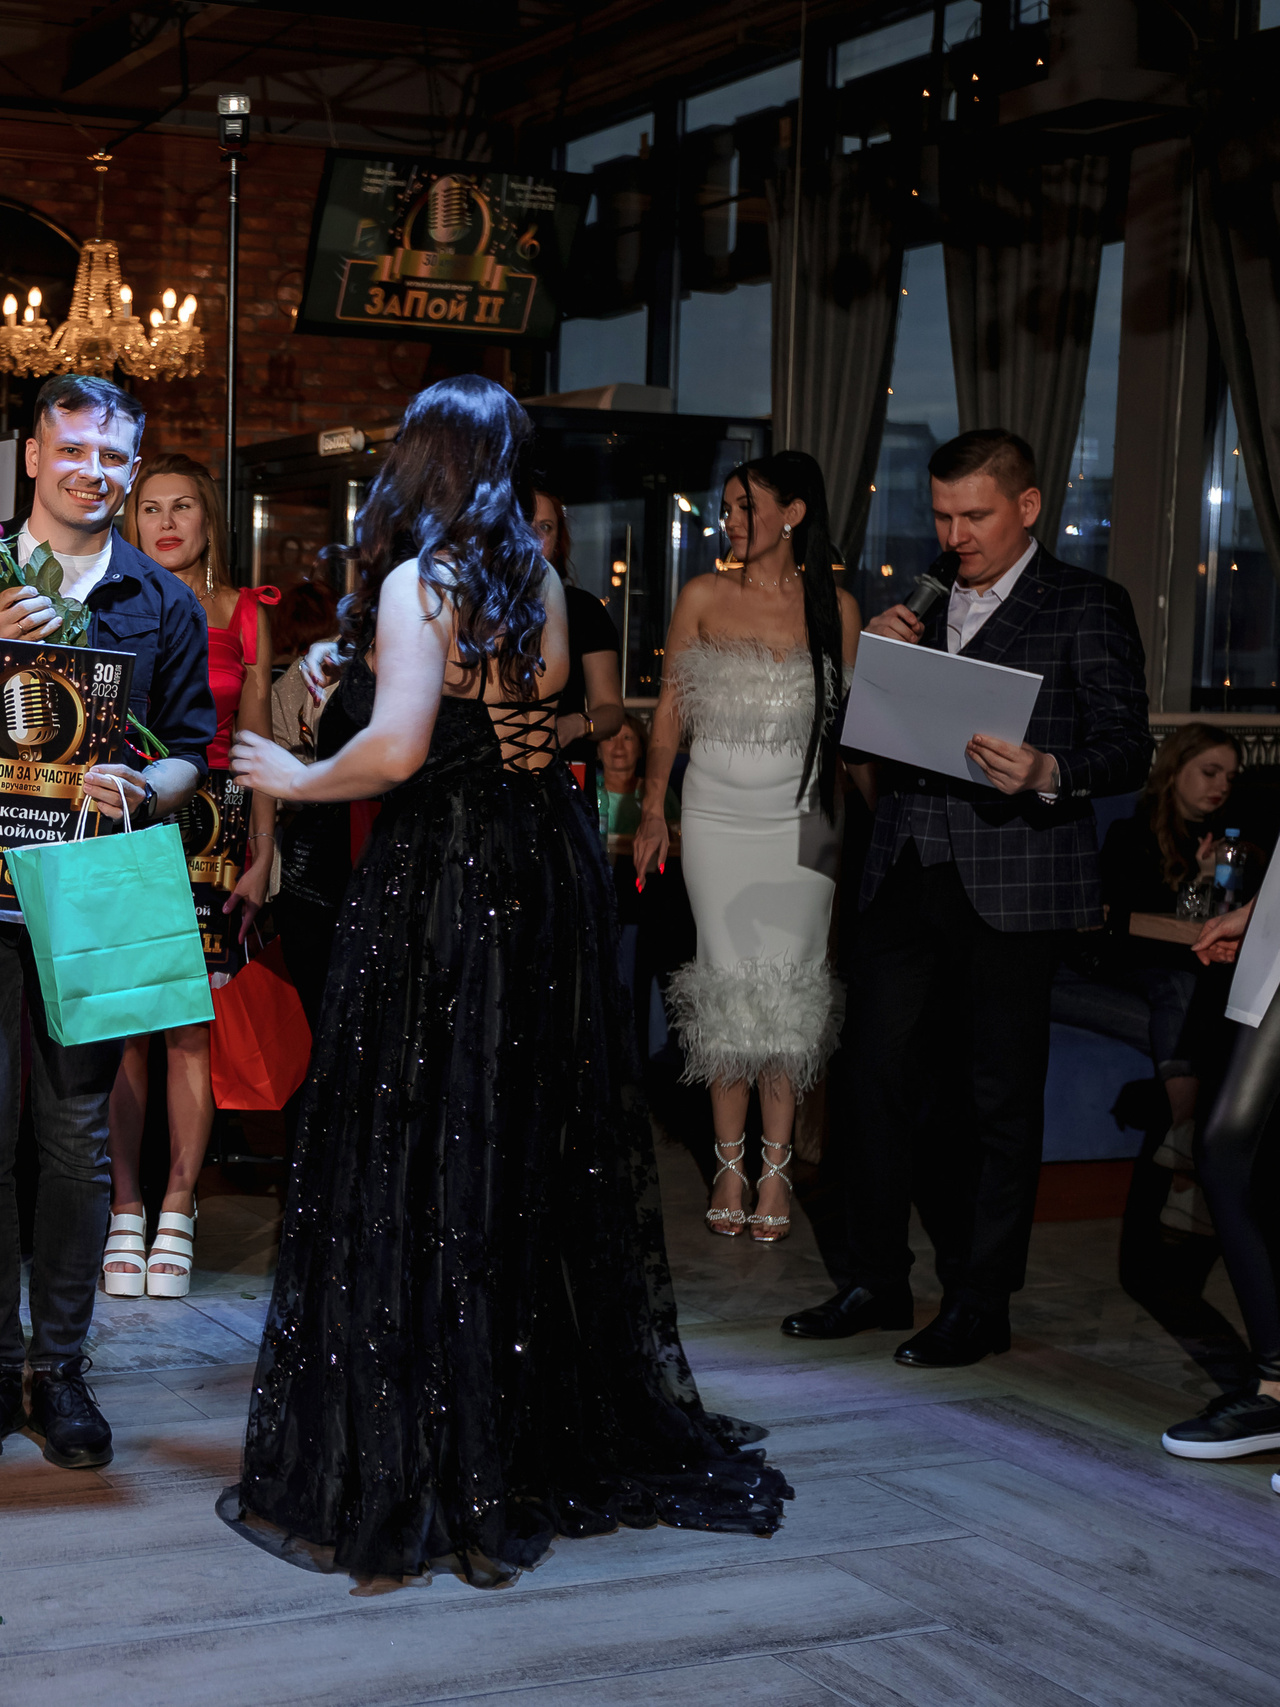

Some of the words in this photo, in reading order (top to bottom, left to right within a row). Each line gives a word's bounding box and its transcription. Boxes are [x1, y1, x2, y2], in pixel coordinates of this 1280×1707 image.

[93, 662, 114, 683] 30
[91, 682, 119, 699] 2023
[17, 766, 31, 781] ЗА
[34, 768, 84, 787] УЧАСТИЕ
[1, 781, 41, 792] вручается
[224, 793, 244, 806] 2023
[203, 933, 223, 953] II
